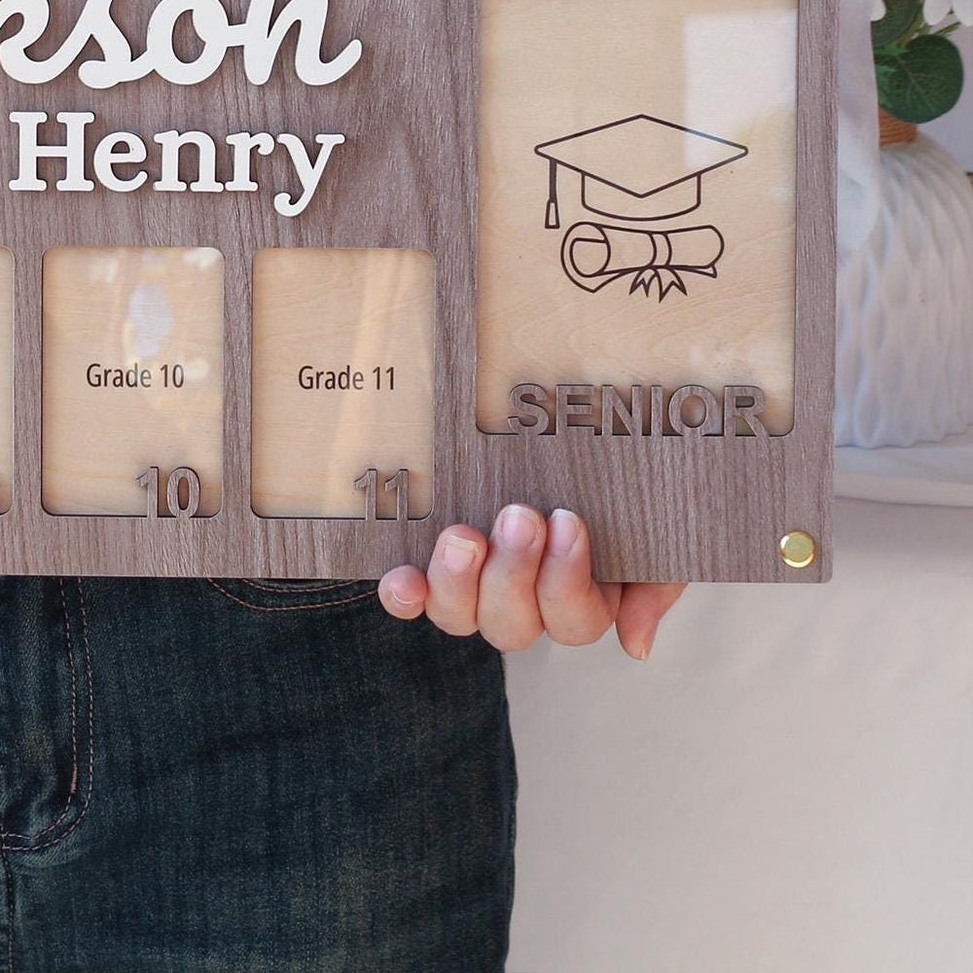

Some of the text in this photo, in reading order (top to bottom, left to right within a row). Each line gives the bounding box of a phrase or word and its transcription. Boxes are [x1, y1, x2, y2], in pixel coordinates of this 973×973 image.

[8, 110, 346, 218] Henry
[86, 363, 185, 389] Grade 10
[298, 365, 395, 392] Grade 11
[507, 383, 767, 437] SENIOR
[134, 466, 201, 519] 10
[353, 468, 410, 520] 11
